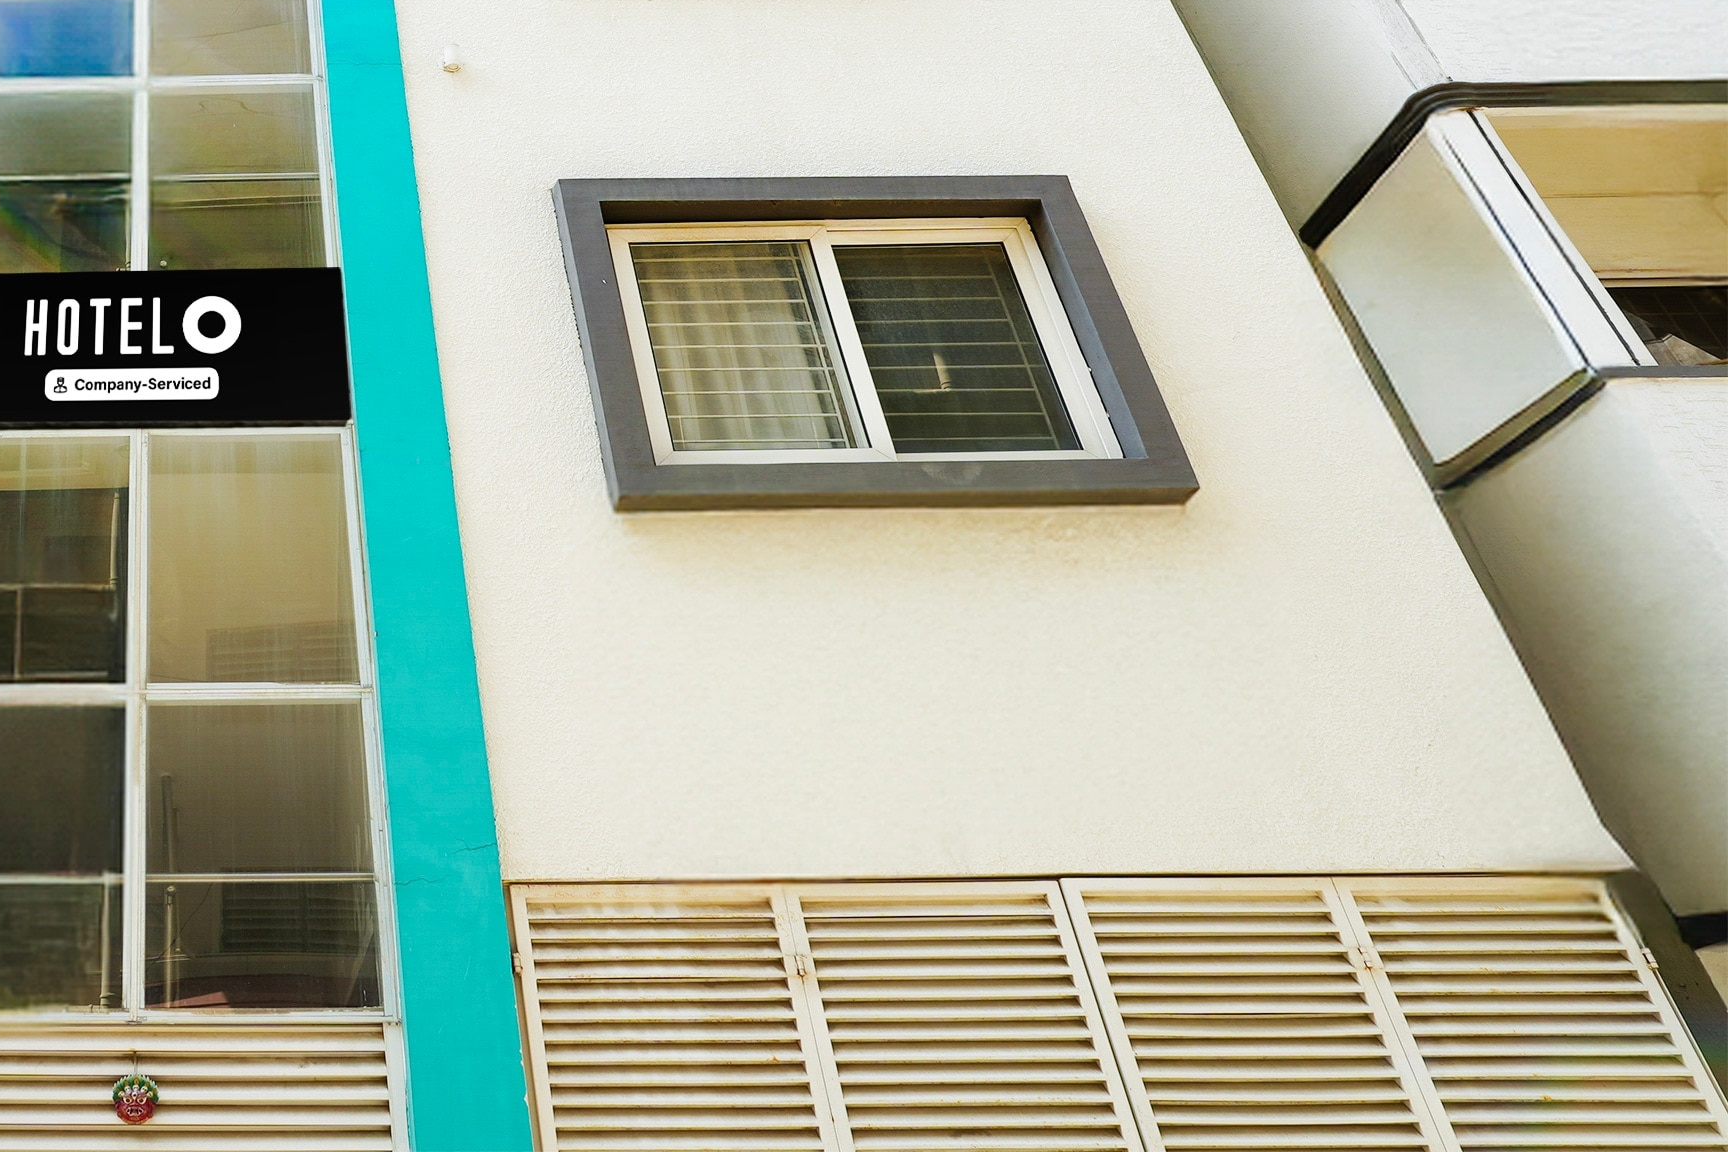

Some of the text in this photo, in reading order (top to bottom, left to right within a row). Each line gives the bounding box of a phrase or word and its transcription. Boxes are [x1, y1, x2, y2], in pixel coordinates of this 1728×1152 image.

[24, 296, 242, 356] HOTEL O
[74, 376, 211, 394] Company-Serviced
